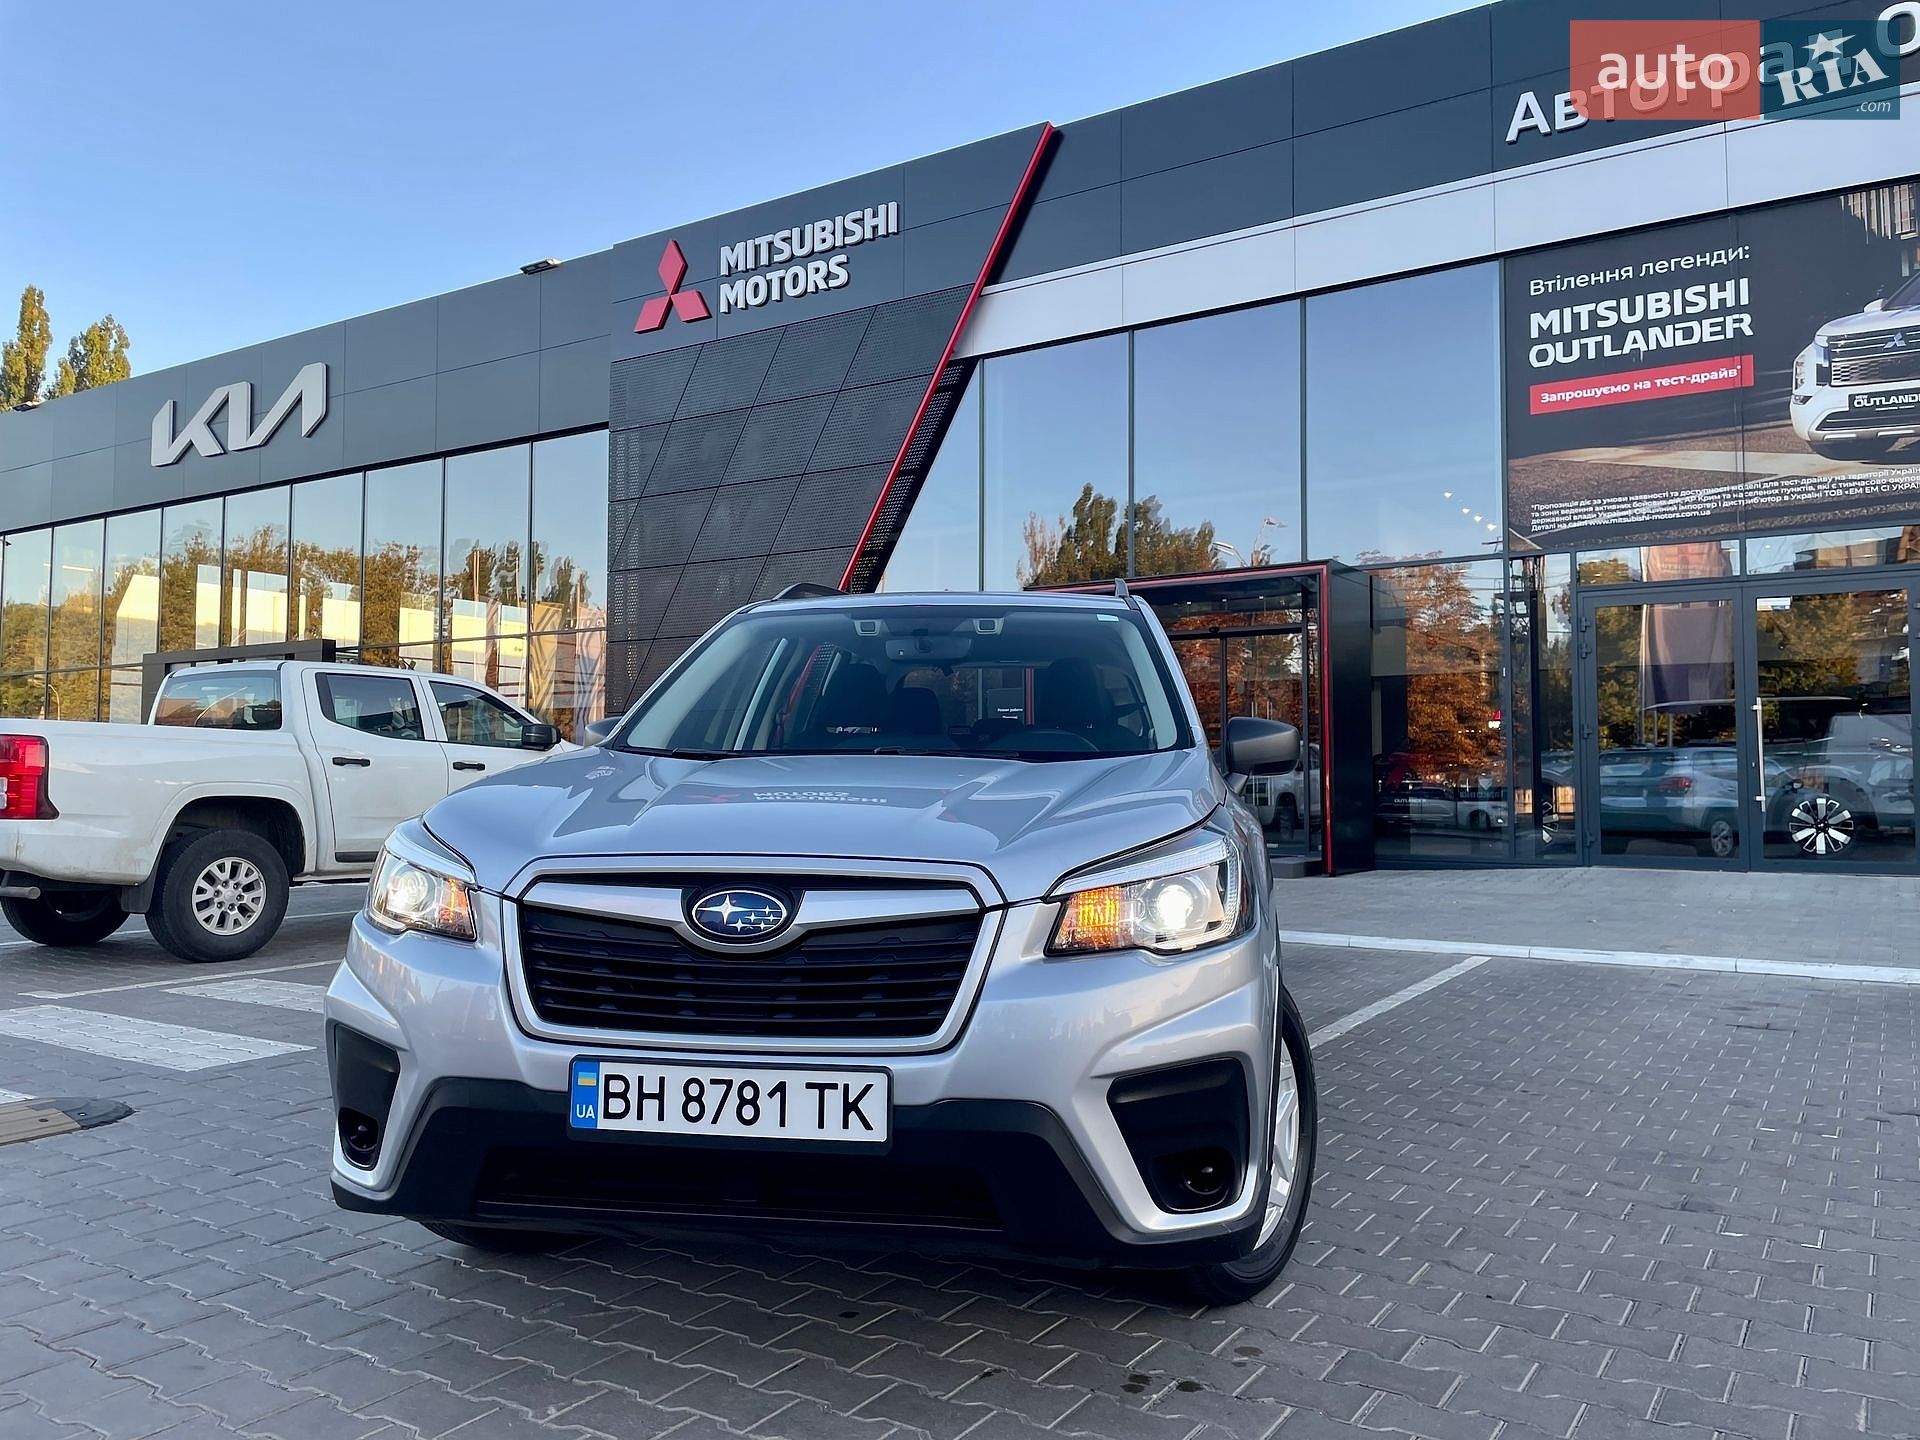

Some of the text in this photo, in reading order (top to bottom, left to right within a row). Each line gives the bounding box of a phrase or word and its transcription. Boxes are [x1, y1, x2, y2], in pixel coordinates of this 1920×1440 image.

[720, 201, 899, 277] MITSUBISHI
[720, 254, 850, 314] MOTORS
[1530, 245, 1751, 296] Втілення легенди:
[1530, 277, 1750, 339] MITSUBISHI
[1529, 313, 1754, 369] OUTLANDER
[150, 361, 327, 467] KIA
[1540, 382, 1630, 404] Запрошуємо
[1633, 378, 1651, 392] на
[1854, 393, 1920, 408] OUTLAND
[576, 1104, 596, 1119] UA
[603, 1073, 875, 1131] BH 8781 TK
